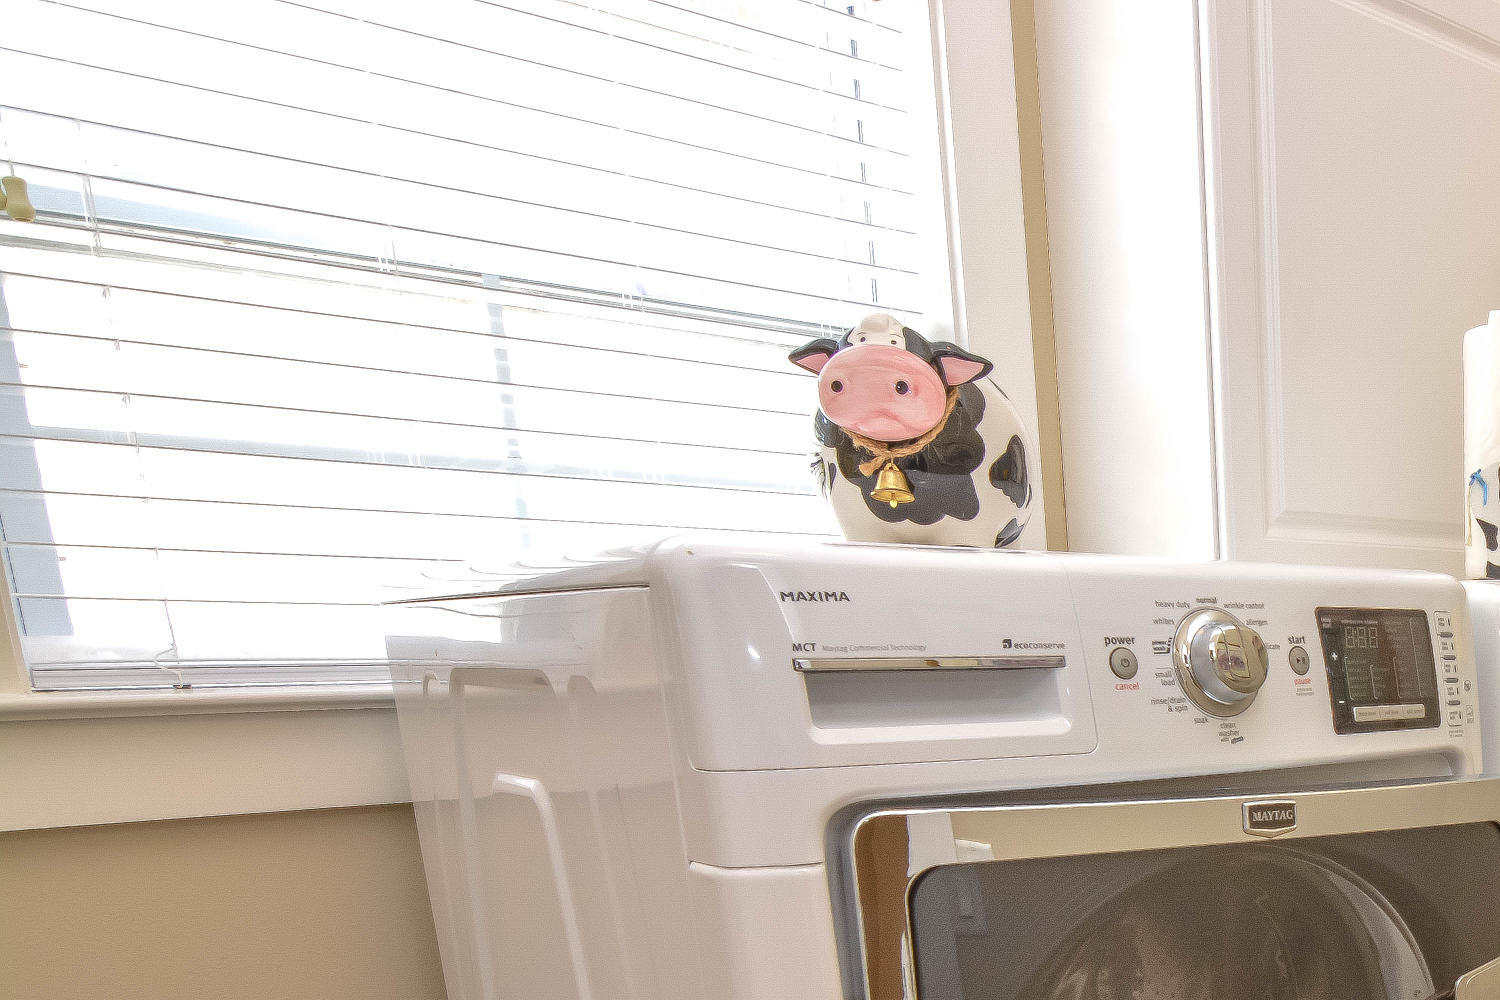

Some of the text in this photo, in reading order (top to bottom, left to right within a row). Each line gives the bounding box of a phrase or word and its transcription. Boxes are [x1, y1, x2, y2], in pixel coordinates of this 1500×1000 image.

[780, 591, 850, 602] MAXIMA
[1155, 600, 1190, 609] heavy duty
[1152, 617, 1175, 625] whites
[1104, 636, 1136, 646] power
[1288, 635, 1306, 644] start
[792, 642, 816, 652] MCT
[849, 643, 889, 652] Commercial
[890, 642, 927, 653] Technology
[1013, 642, 1065, 650] ecoconserve
[1115, 682, 1140, 691] cancel
[1252, 809, 1294, 822] MAYTAG
